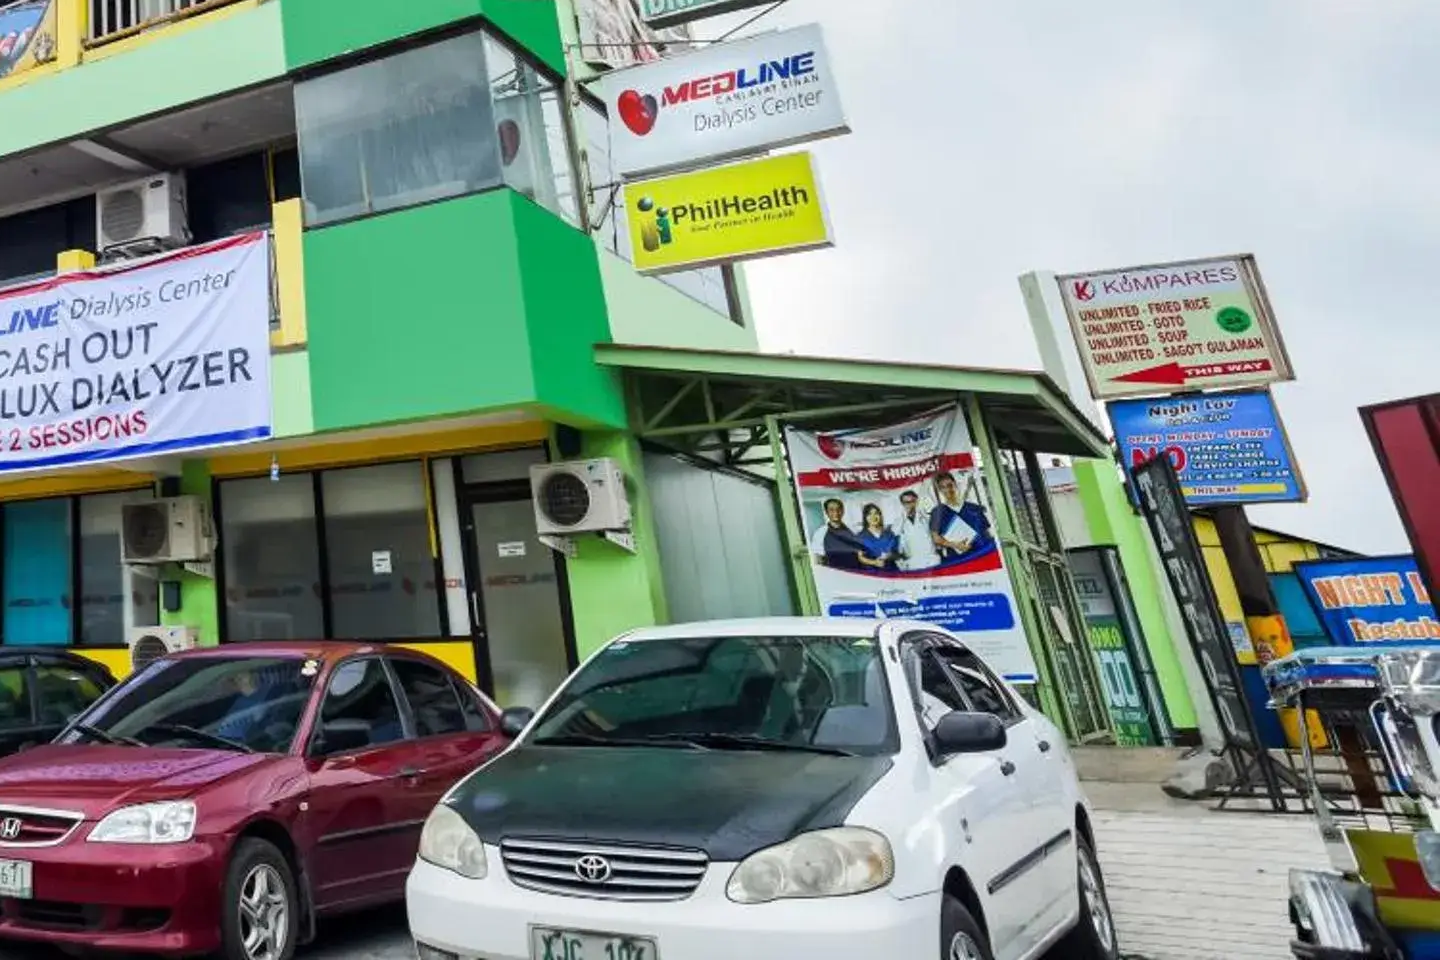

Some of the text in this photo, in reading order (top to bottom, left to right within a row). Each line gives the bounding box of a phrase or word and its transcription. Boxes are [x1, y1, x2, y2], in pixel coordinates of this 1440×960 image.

[661, 51, 816, 108] MEDLINE
[693, 88, 823, 133] Dialysis Center
[671, 185, 810, 225] PhilHealth
[69, 284, 152, 321] Dialysis
[158, 267, 237, 303] Center
[1079, 306, 1140, 322] UNLIMITED
[1148, 301, 1182, 315] FRIED
[1183, 297, 1211, 310] RICE
[82, 322, 160, 364] OUT
[1083, 320, 1144, 337] UNLIMITED
[1154, 316, 1185, 330] GOTO
[1088, 334, 1150, 351] UNLIMITED
[1157, 330, 1190, 344] SOUP
[1093, 349, 1155, 366] UNLIMITED
[1207, 338, 1265, 354] GULAMAN
[71, 346, 253, 411] DIALYZER
[1184, 362, 1264, 377] THIS WAY
[1149, 400, 1199, 417] Night
[9, 428, 24, 452] 2
[28, 410, 148, 450] SESSIONS
[829, 458, 940, 484] WE'RE HIRING!
[1131, 444, 1188, 473] NO
[1311, 572, 1407, 610] NIGHT
